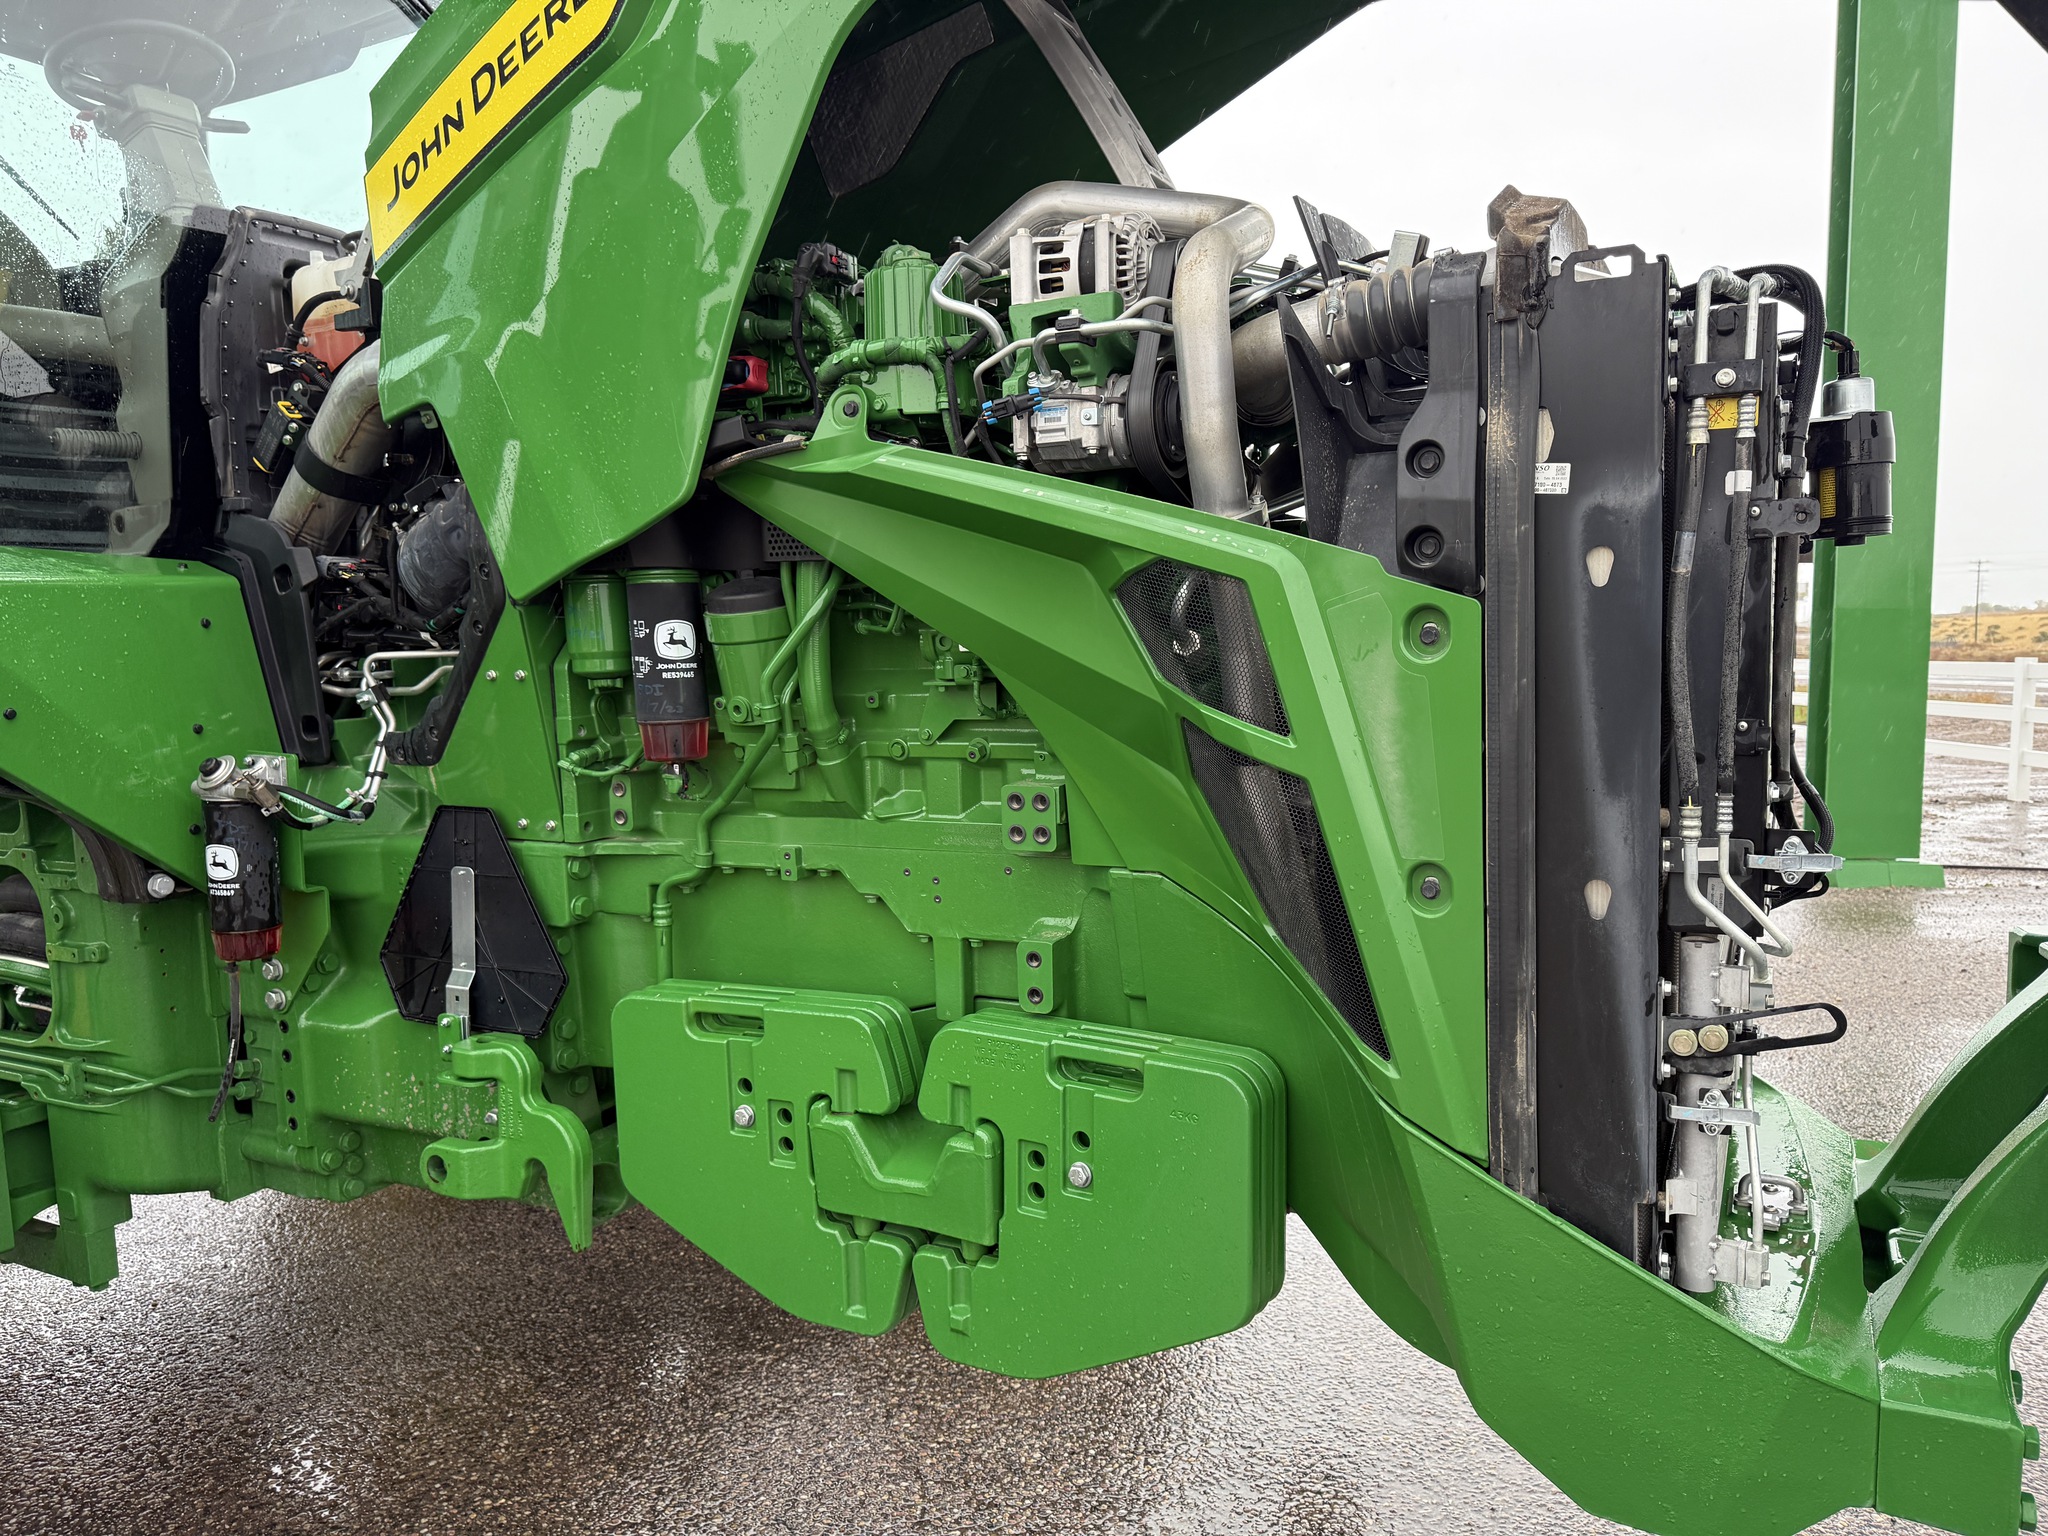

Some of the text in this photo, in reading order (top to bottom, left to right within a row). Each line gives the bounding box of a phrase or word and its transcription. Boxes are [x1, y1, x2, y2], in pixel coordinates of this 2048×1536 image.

[386, 97, 465, 213] JOHN
[662, 671, 694, 679] RE539465
[974, 1056, 996, 1067] MADE
[1010, 1062, 1026, 1072] USA
[1169, 1109, 1199, 1124] 45KG
